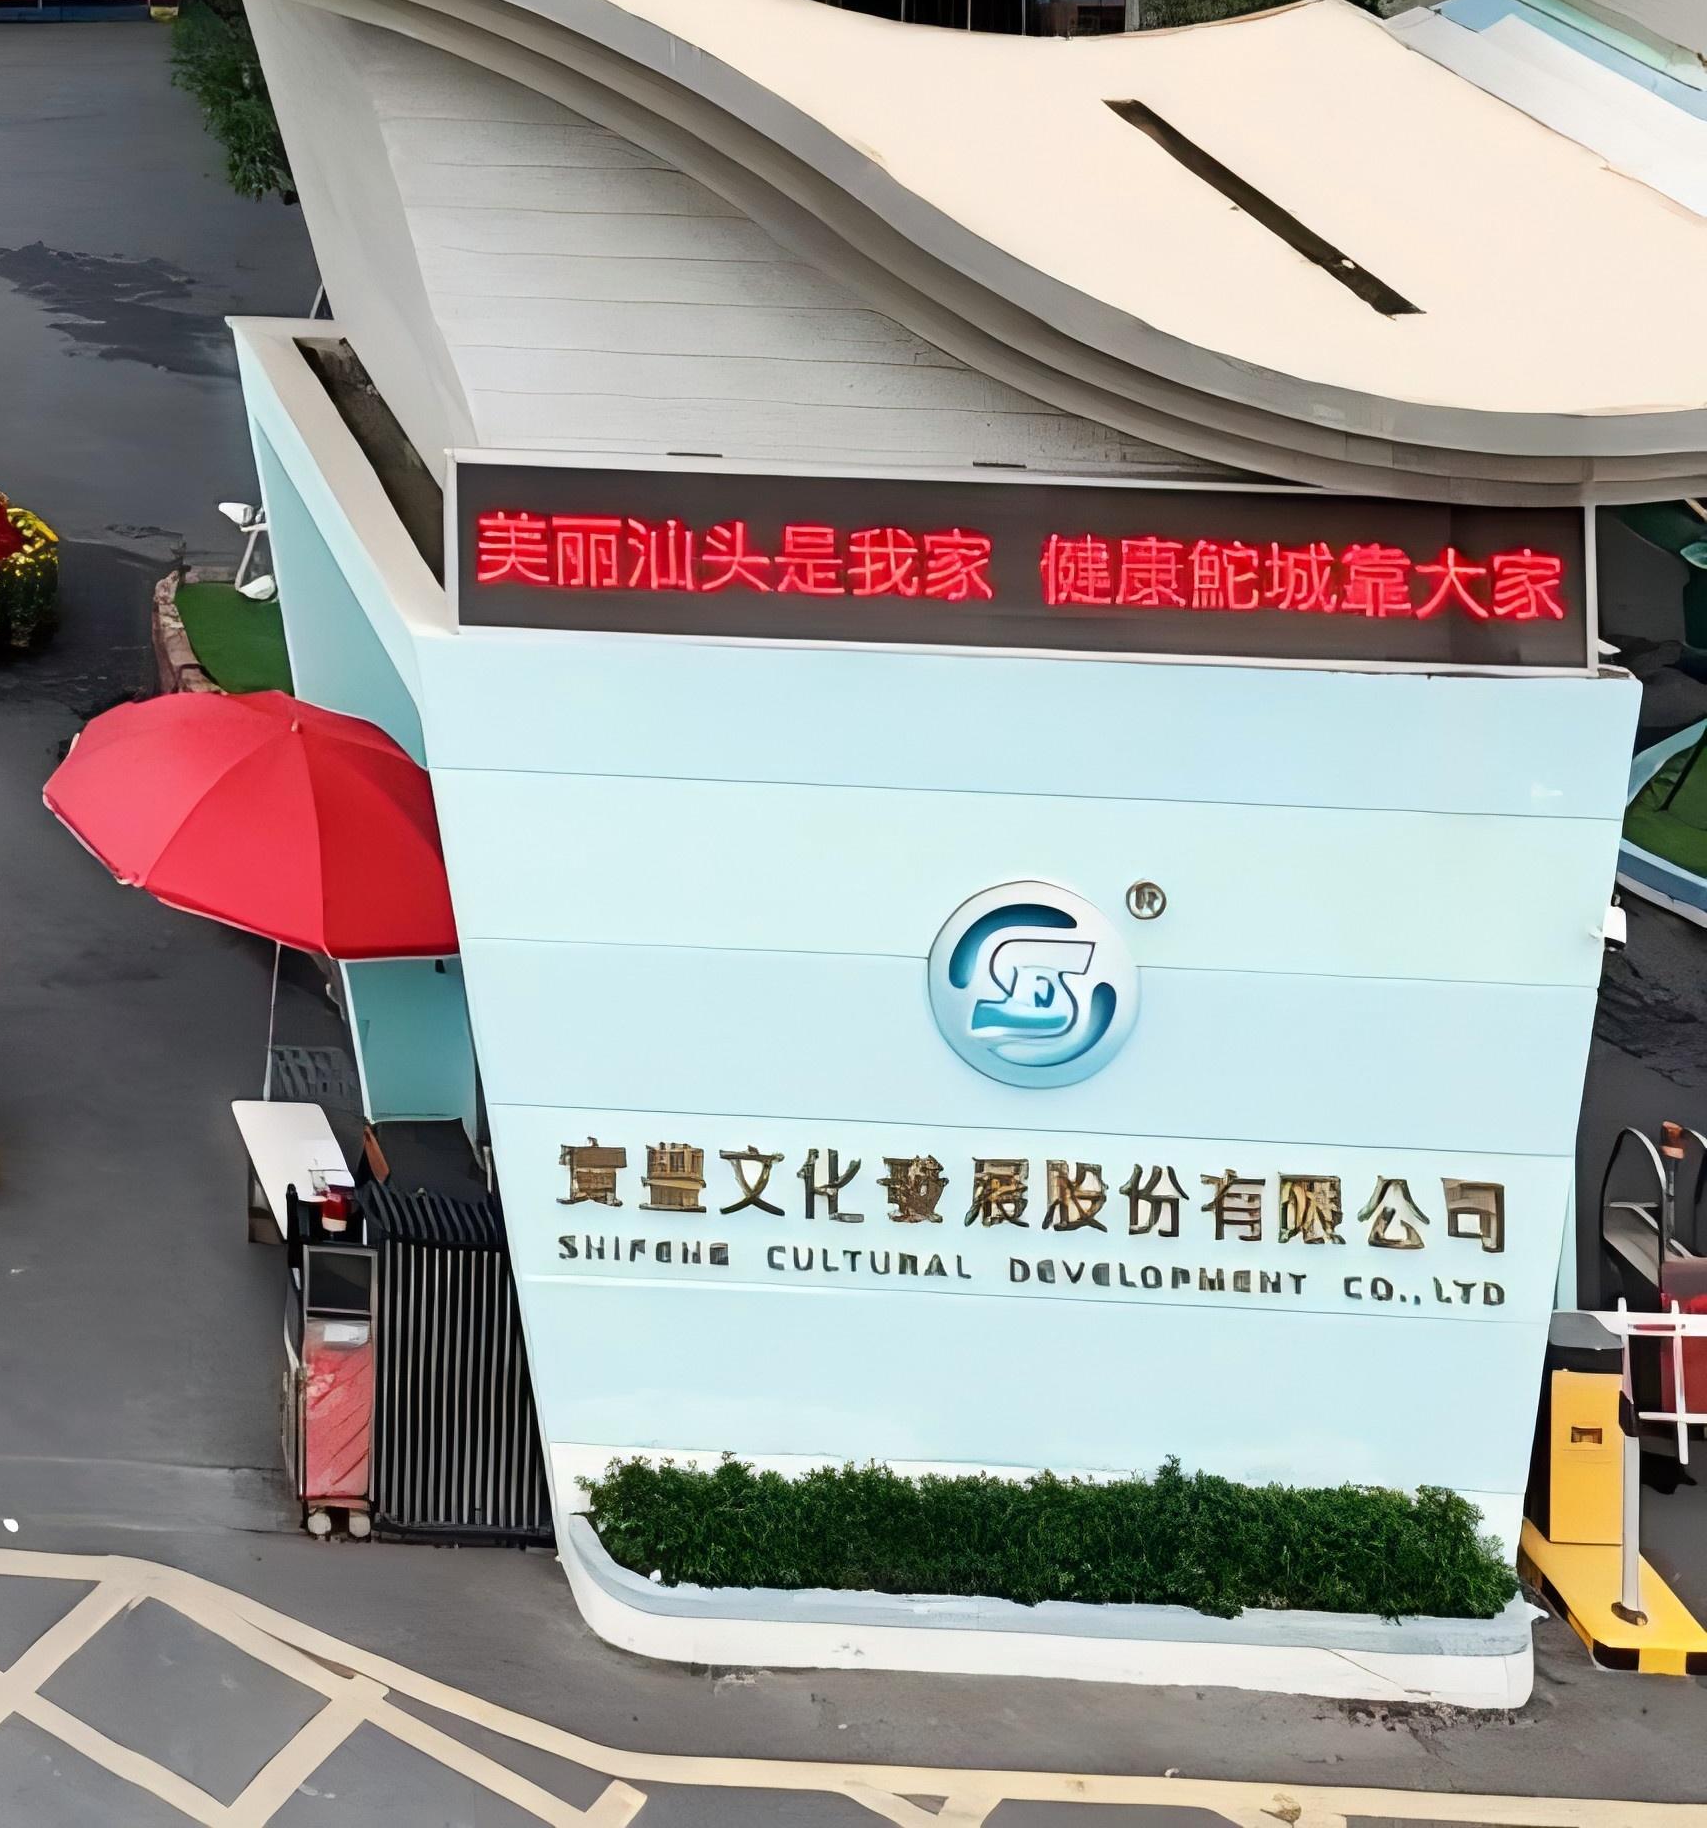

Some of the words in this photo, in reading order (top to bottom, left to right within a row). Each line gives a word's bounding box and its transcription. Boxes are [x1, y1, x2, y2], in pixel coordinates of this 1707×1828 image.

[476, 512, 994, 600] 美丽汕头是我家
[1040, 533, 1566, 620] 健康鮀城靠大家
[766, 1245, 973, 1280] CULTURAL
[1008, 1256, 1308, 1295] DEVELOPMENT
